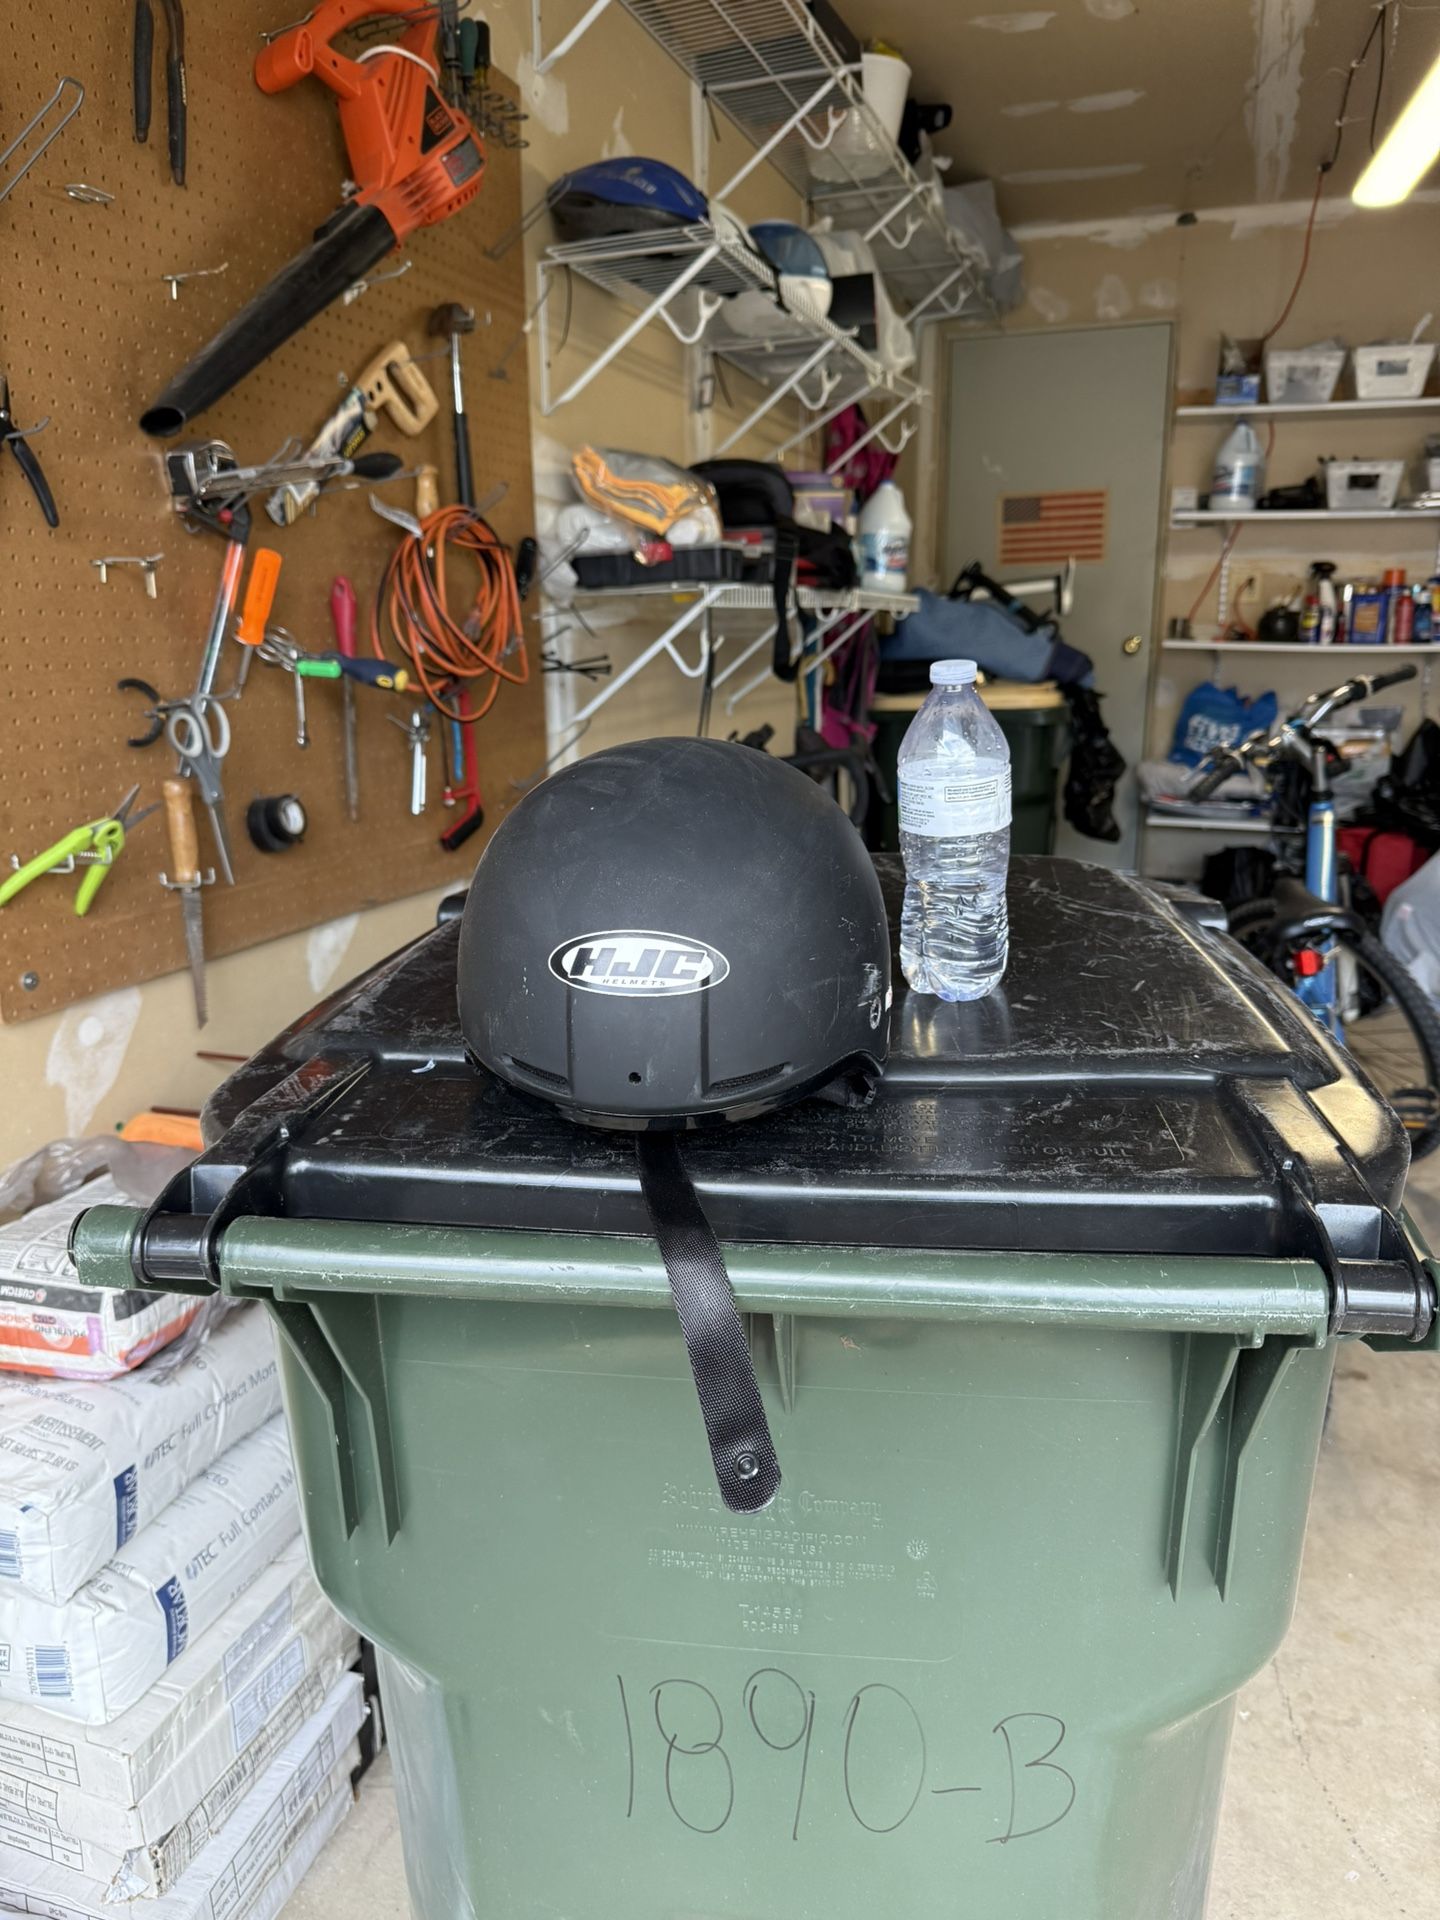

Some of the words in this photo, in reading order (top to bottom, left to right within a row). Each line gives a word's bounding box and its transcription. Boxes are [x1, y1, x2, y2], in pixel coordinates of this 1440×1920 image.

[569, 947, 707, 980] HJC
[602, 978, 666, 986] HELMETS
[883, 1135, 937, 1144] MOVE
[181, 1414, 202, 1439] Full
[218, 1520, 243, 1549] Full
[240, 1482, 285, 1527] Contact
[617, 1667, 1076, 1844] 1890-B
